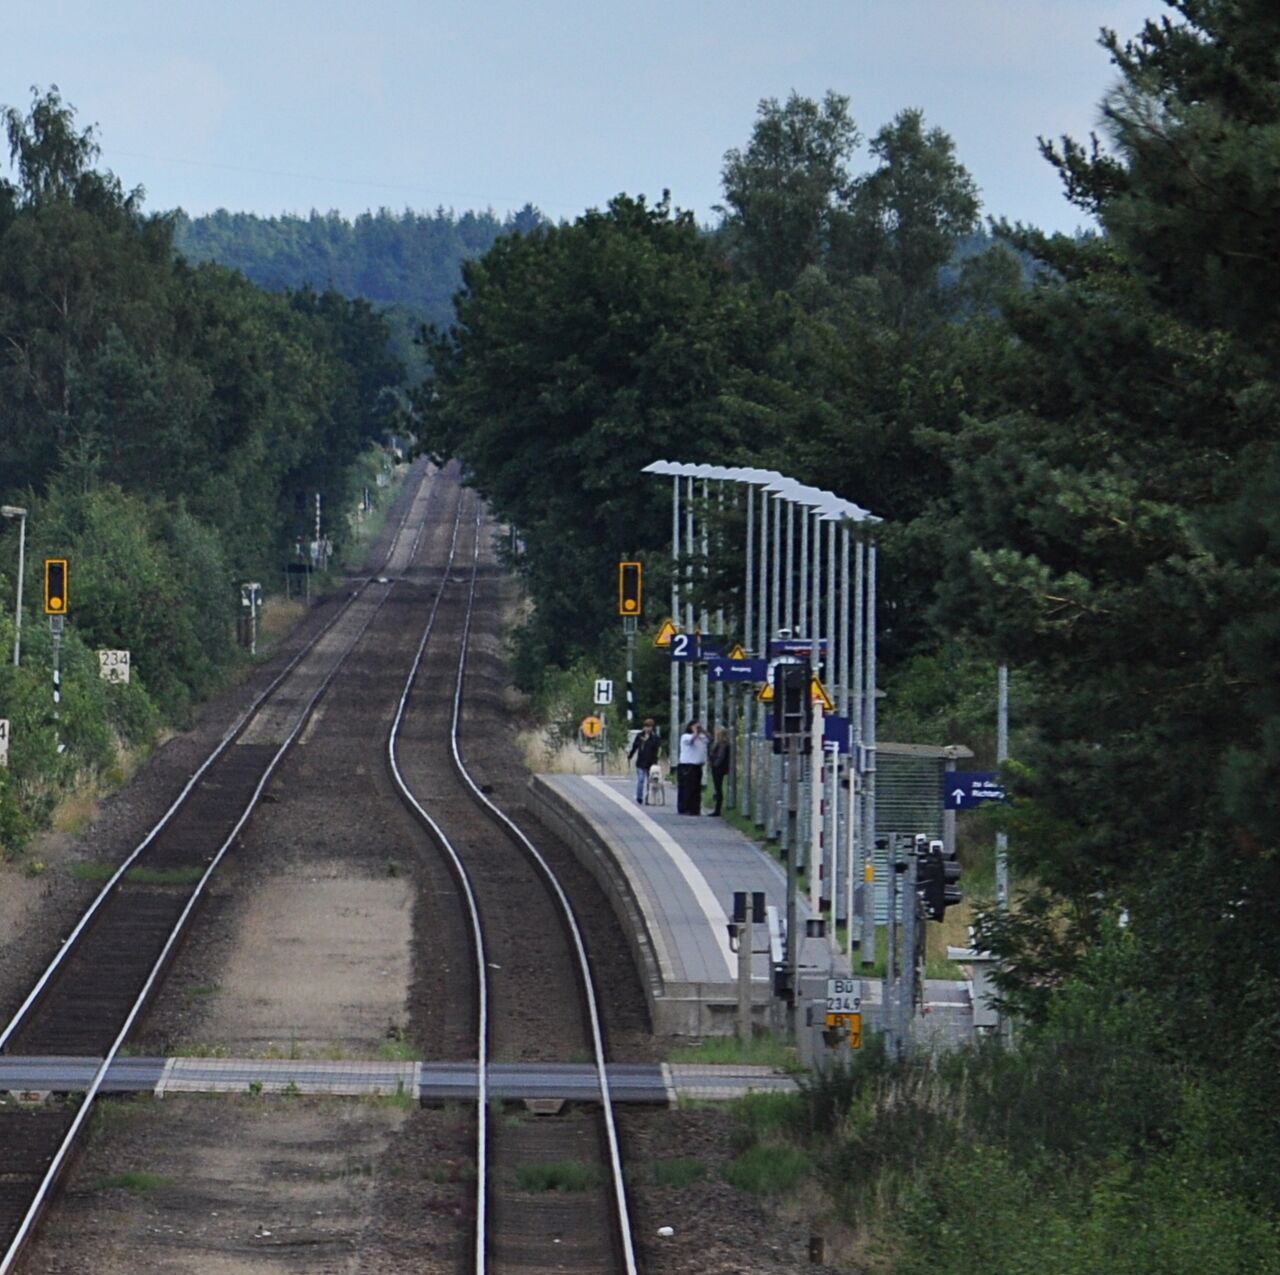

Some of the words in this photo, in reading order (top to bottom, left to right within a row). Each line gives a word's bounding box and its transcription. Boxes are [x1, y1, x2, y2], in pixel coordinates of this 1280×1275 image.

[673, 634, 689, 657] 2
[101, 652, 128, 666] 234
[834, 980, 853, 994] Bü
